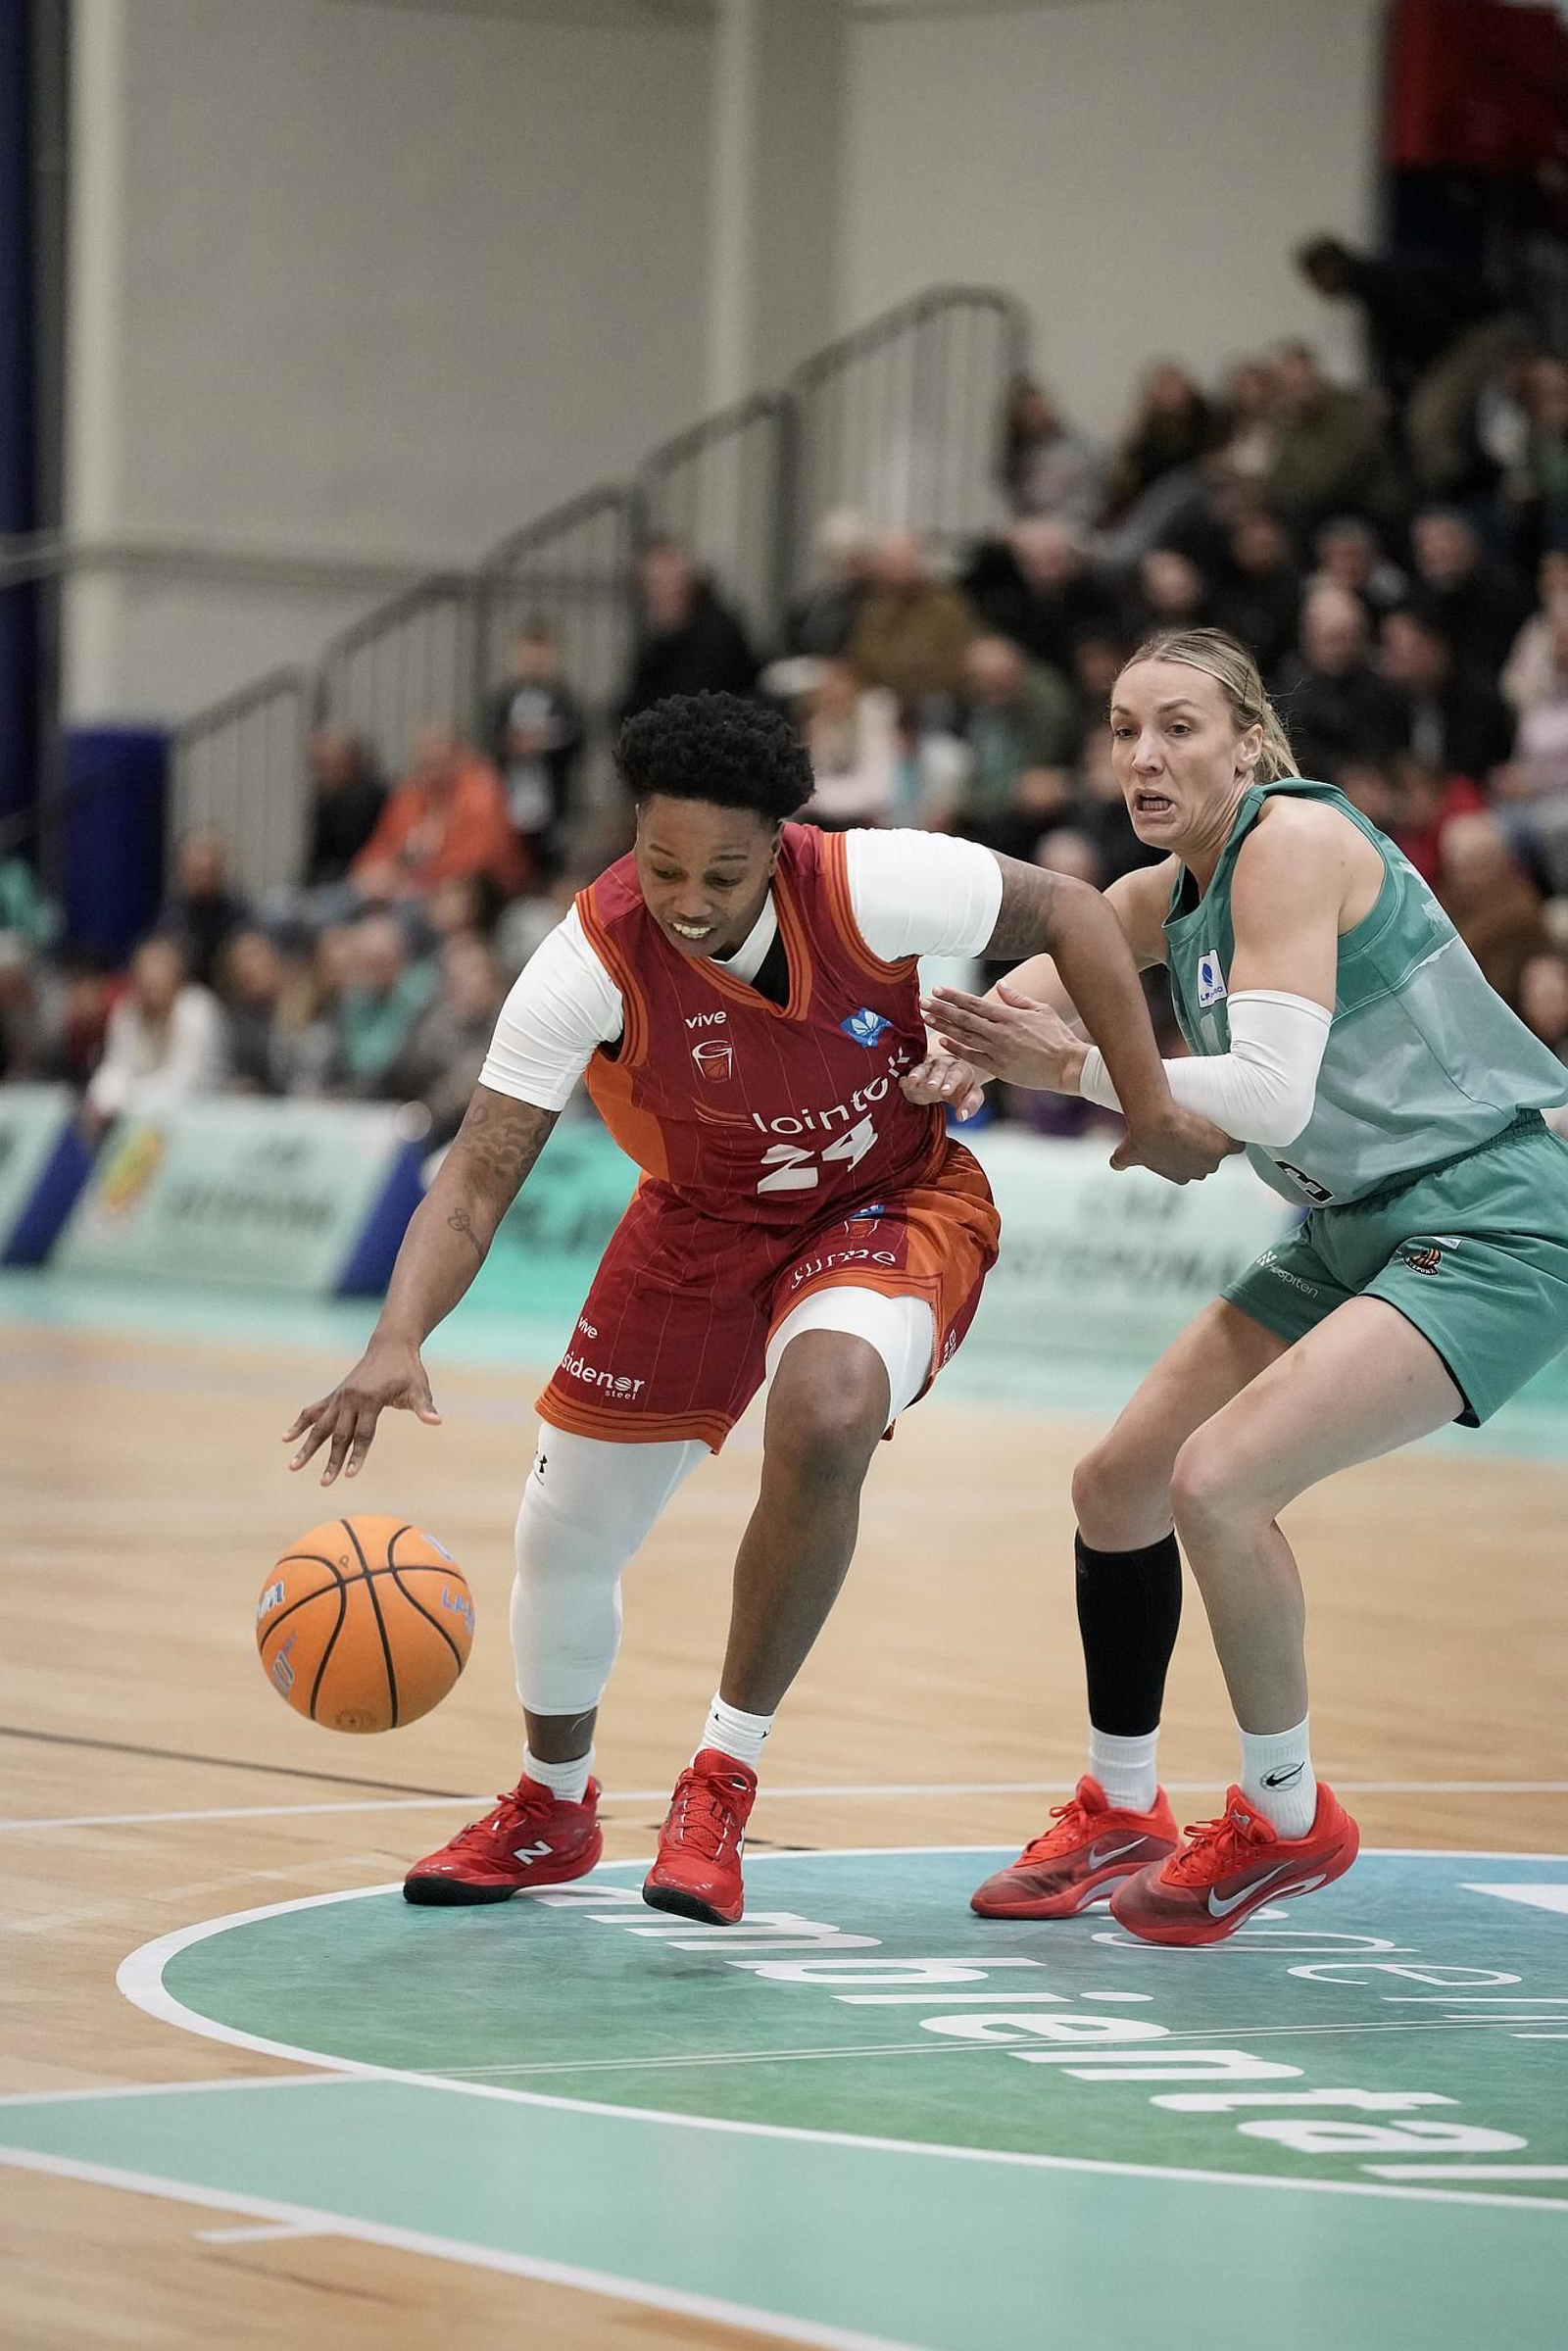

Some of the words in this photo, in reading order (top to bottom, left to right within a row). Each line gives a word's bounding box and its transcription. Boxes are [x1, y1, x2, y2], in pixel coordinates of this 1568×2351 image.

[685, 1010, 727, 1029] vive
[758, 1113, 879, 1195] 24
[578, 1316, 598, 1339] vive
[562, 1350, 646, 1393] sidenor
[605, 1390, 637, 1400] steel
